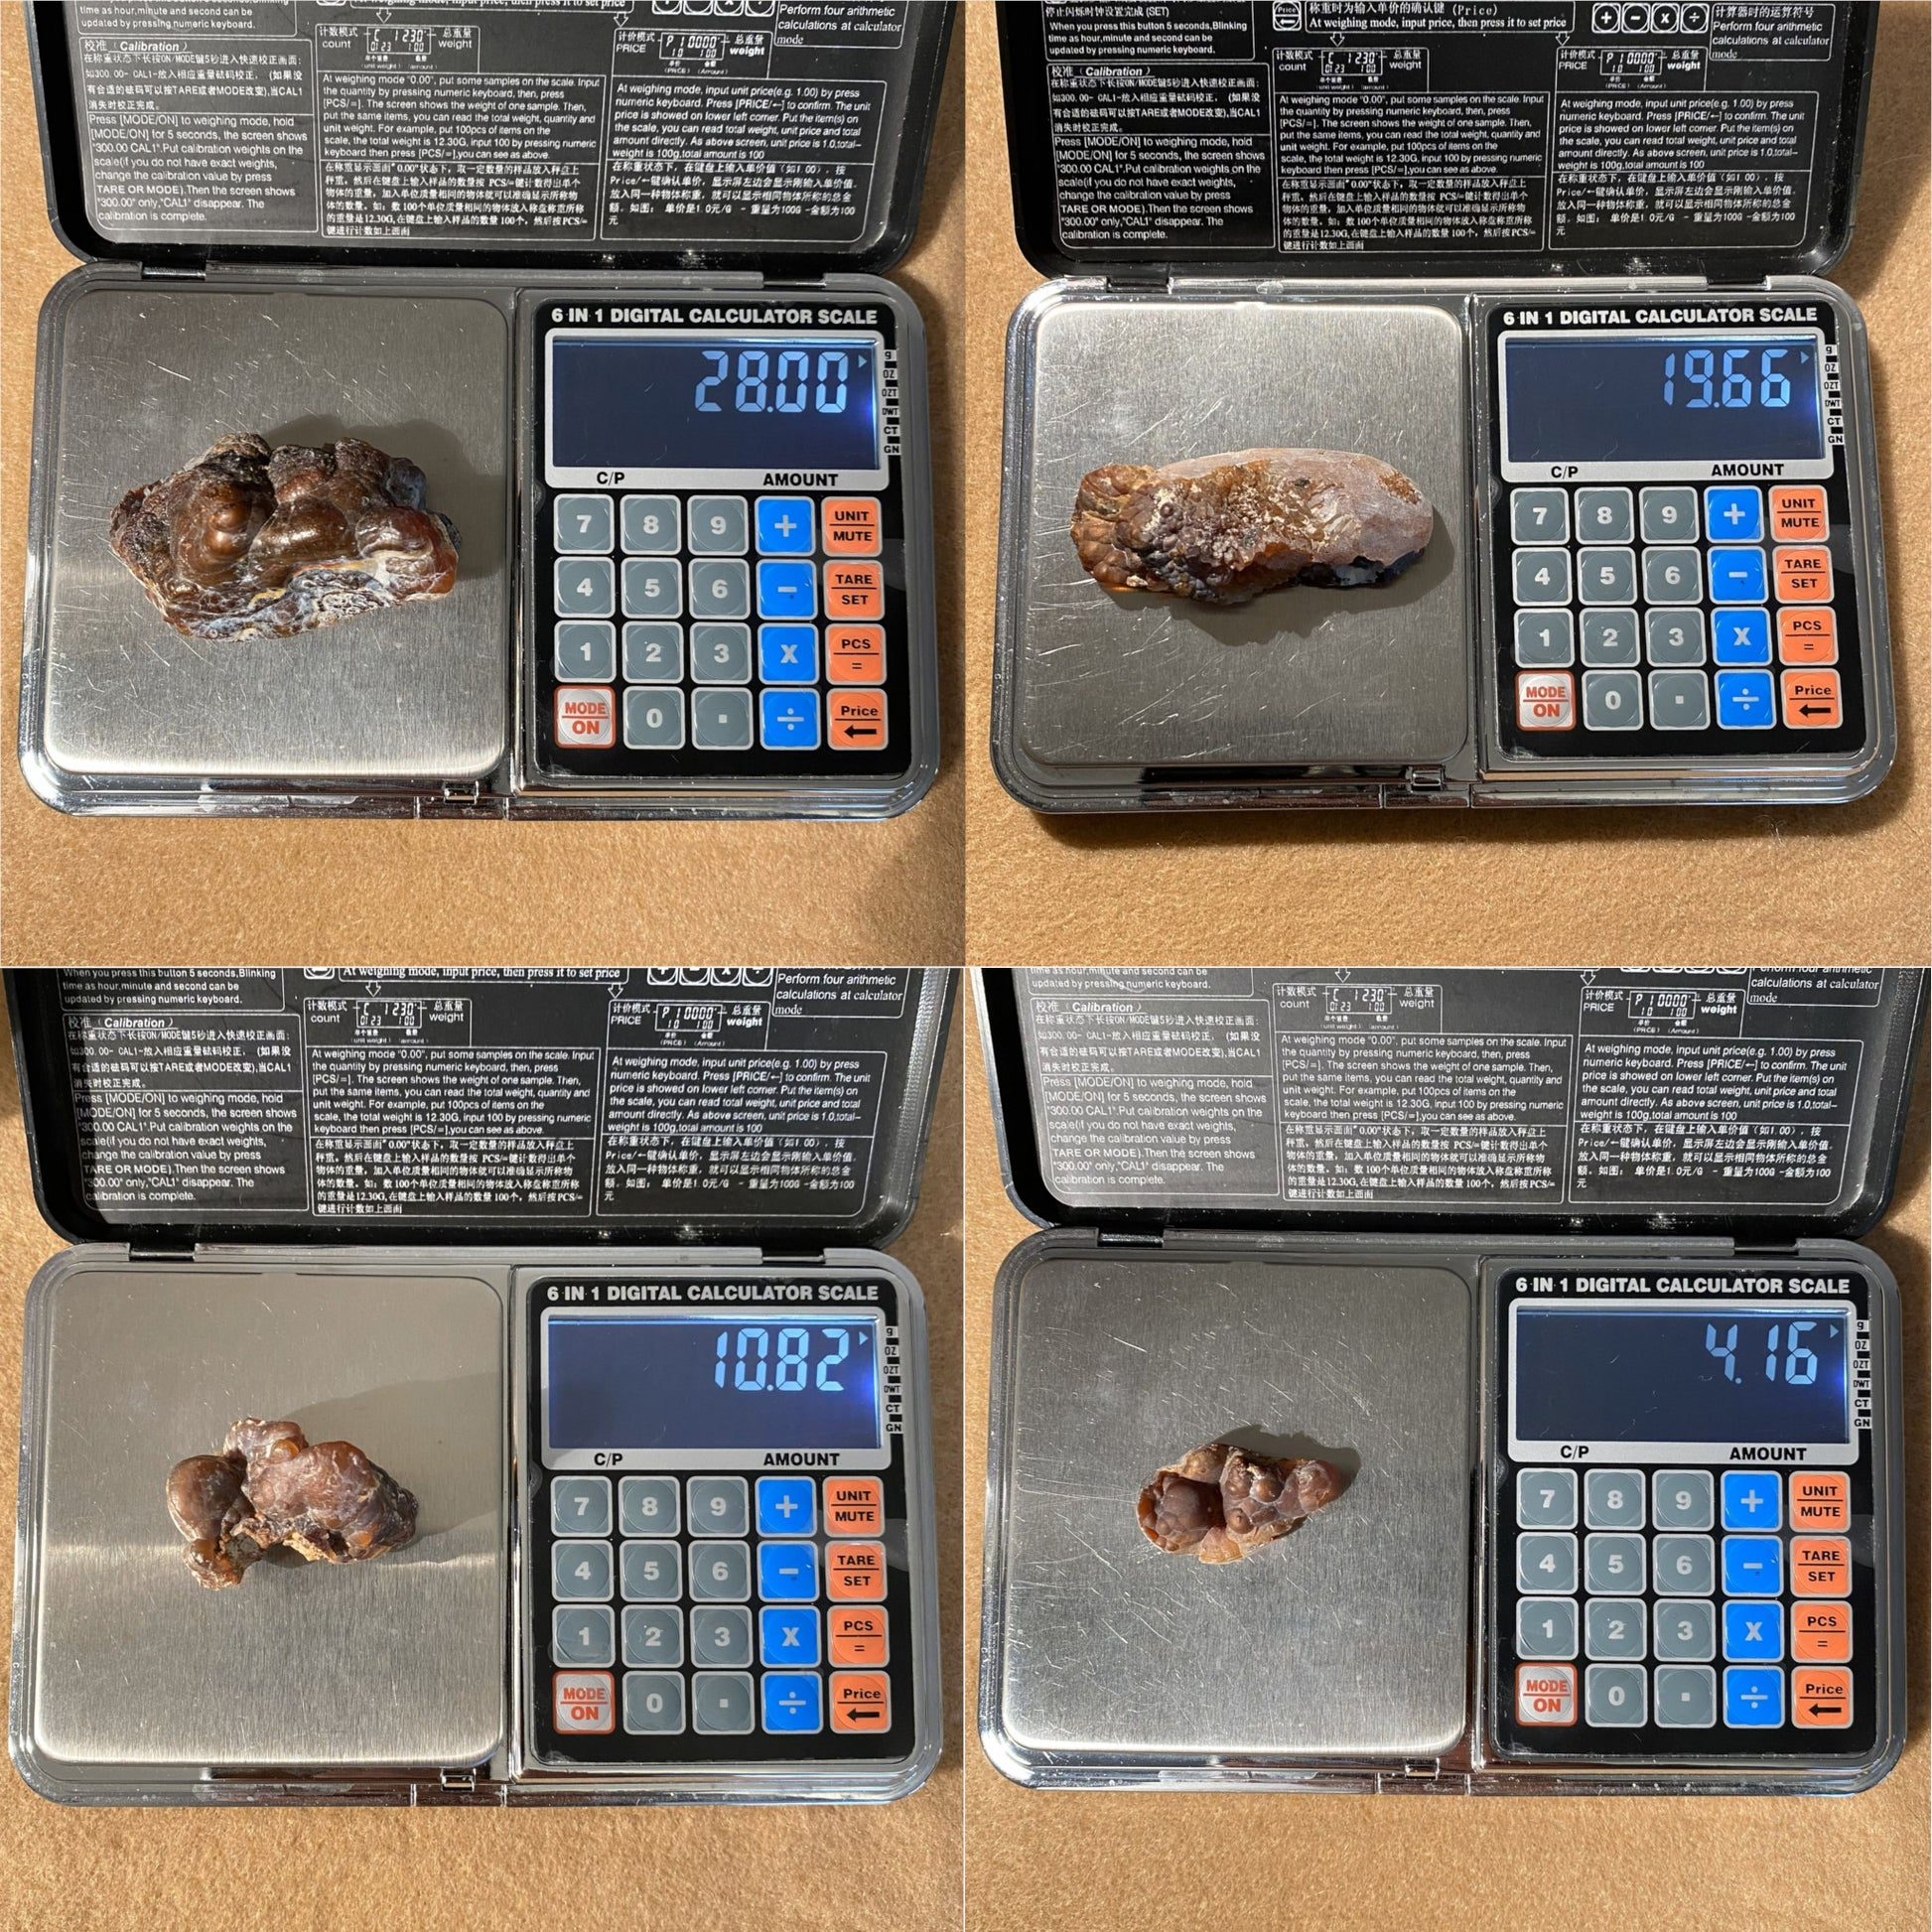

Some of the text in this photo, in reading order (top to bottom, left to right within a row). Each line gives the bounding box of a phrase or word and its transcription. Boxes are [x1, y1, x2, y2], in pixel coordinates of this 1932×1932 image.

[780, 4, 895, 16] Perform four arithmetic
[778, 20, 837, 31] calculations
[854, 21, 903, 35] calculator
[1310, 18, 1320, 27] At
[1324, 17, 1367, 30] weighing
[1402, 17, 1426, 30] input
[1458, 17, 1477, 27] then
[1480, 20, 1504, 29] press
[1544, 20, 1566, 29] price
[439, 40, 472, 50] weight
[775, 34, 805, 47] mode
[617, 44, 645, 53] PRICE
[730, 47, 764, 57] weight
[552, 309, 877, 324] 6 IN 1 DIGITAL CALCULATOR SCALE
[1504, 308, 1817, 325] 6 IN 1 DIGITAL CALCULATOR SCALE
[696, 350, 848, 413] 28.00
[1665, 349, 1790, 407] 19.66
[1552, 467, 1578, 479] C/P
[1712, 464, 1784, 476] AMOUNT
[597, 472, 624, 483] C/P
[763, 474, 838, 485] AMOUNT
[1782, 499, 1815, 508] UNIT
[835, 511, 869, 520] UNIT
[577, 515, 591, 532] 7
[643, 515, 658, 533] 8
[711, 516, 726, 534] 9
[1782, 518, 1819, 527] MUTE
[834, 531, 872, 541] MUTE
[1785, 559, 1821, 568] TARE
[836, 575, 872, 584] TARE
[1792, 579, 1817, 588] SET
[577, 579, 593, 596] 4
[645, 579, 659, 597] 5
[712, 580, 727, 598] 6
[842, 595, 868, 605] SET
[1793, 621, 1821, 630] PCS
[842, 639, 871, 648] PCS
[581, 642, 591, 660] 1
[646, 643, 660, 661] 2
[714, 644, 729, 662] 3
[1527, 687, 1566, 698] MODE
[1795, 685, 1831, 695] Price
[566, 703, 606, 714] MODE
[842, 706, 878, 716] Price
[1534, 704, 1560, 717] ON
[646, 709, 662, 728] 0
[573, 721, 599, 734] ON
[66, 995, 101, 1004] updated
[104, 995, 114, 1005] by
[117, 995, 156, 1005] pressing
[1584, 1003, 1614, 1012] PRICE
[1702, 1005, 1736, 1015] weight
[313, 1088, 328, 1097] put
[331, 1087, 345, 1096] the
[405, 1089, 422, 1098] you
[538, 1089, 571, 1099] quantity
[1049, 1134, 1087, 1146] change
[1090, 1134, 1105, 1143] the
[1108, 1134, 1158, 1143] calibration
[1161, 1135, 1186, 1144] value
[1189, 1135, 1200, 1145] by
[1516, 1278, 1850, 1294] 6 IN 1 DIGITAL CALCULATOR SCALE
[548, 1286, 878, 1301] 6 IN 1 DIGITAL CALCULATOR SCALE
[1707, 1321, 1817, 1384] 4.16
[715, 1328, 849, 1391] 10.82
[1561, 1446, 1588, 1458] C/P
[1730, 1448, 1807, 1460] AMOUNT
[595, 1452, 622, 1466] C/P
[763, 1452, 840, 1465] AMOUNT
[837, 1491, 871, 1500] UNIT
[1803, 1486, 1838, 1496] UNIT
[1540, 1490, 1555, 1508] 7
[1607, 1490, 1622, 1509] 8
[1676, 1491, 1691, 1509] 9
[836, 1511, 874, 1521] MUTE
[1801, 1507, 1840, 1516] MUTE
[838, 1556, 875, 1565] TARE
[1803, 1551, 1840, 1561] TARE
[1540, 1555, 1555, 1573] 4
[1608, 1555, 1623, 1573] 5
[1677, 1556, 1692, 1575] 6
[844, 1577, 871, 1586] SET
[1809, 1572, 1835, 1582] SET
[844, 1621, 873, 1630] PCS
[1808, 1616, 1837, 1626] PCS
[1543, 1619, 1553, 1638] 1
[1608, 1620, 1624, 1639] 2
[1678, 1621, 1693, 1640] 3
[1527, 1680, 1568, 1692] MODE
[1806, 1684, 1843, 1694] Price
[564, 1689, 605, 1700] MODE
[844, 1689, 881, 1699] Price
[1609, 1687, 1624, 1706] 0
[1534, 1699, 1561, 1712] ON
[572, 1707, 599, 1720] ON
